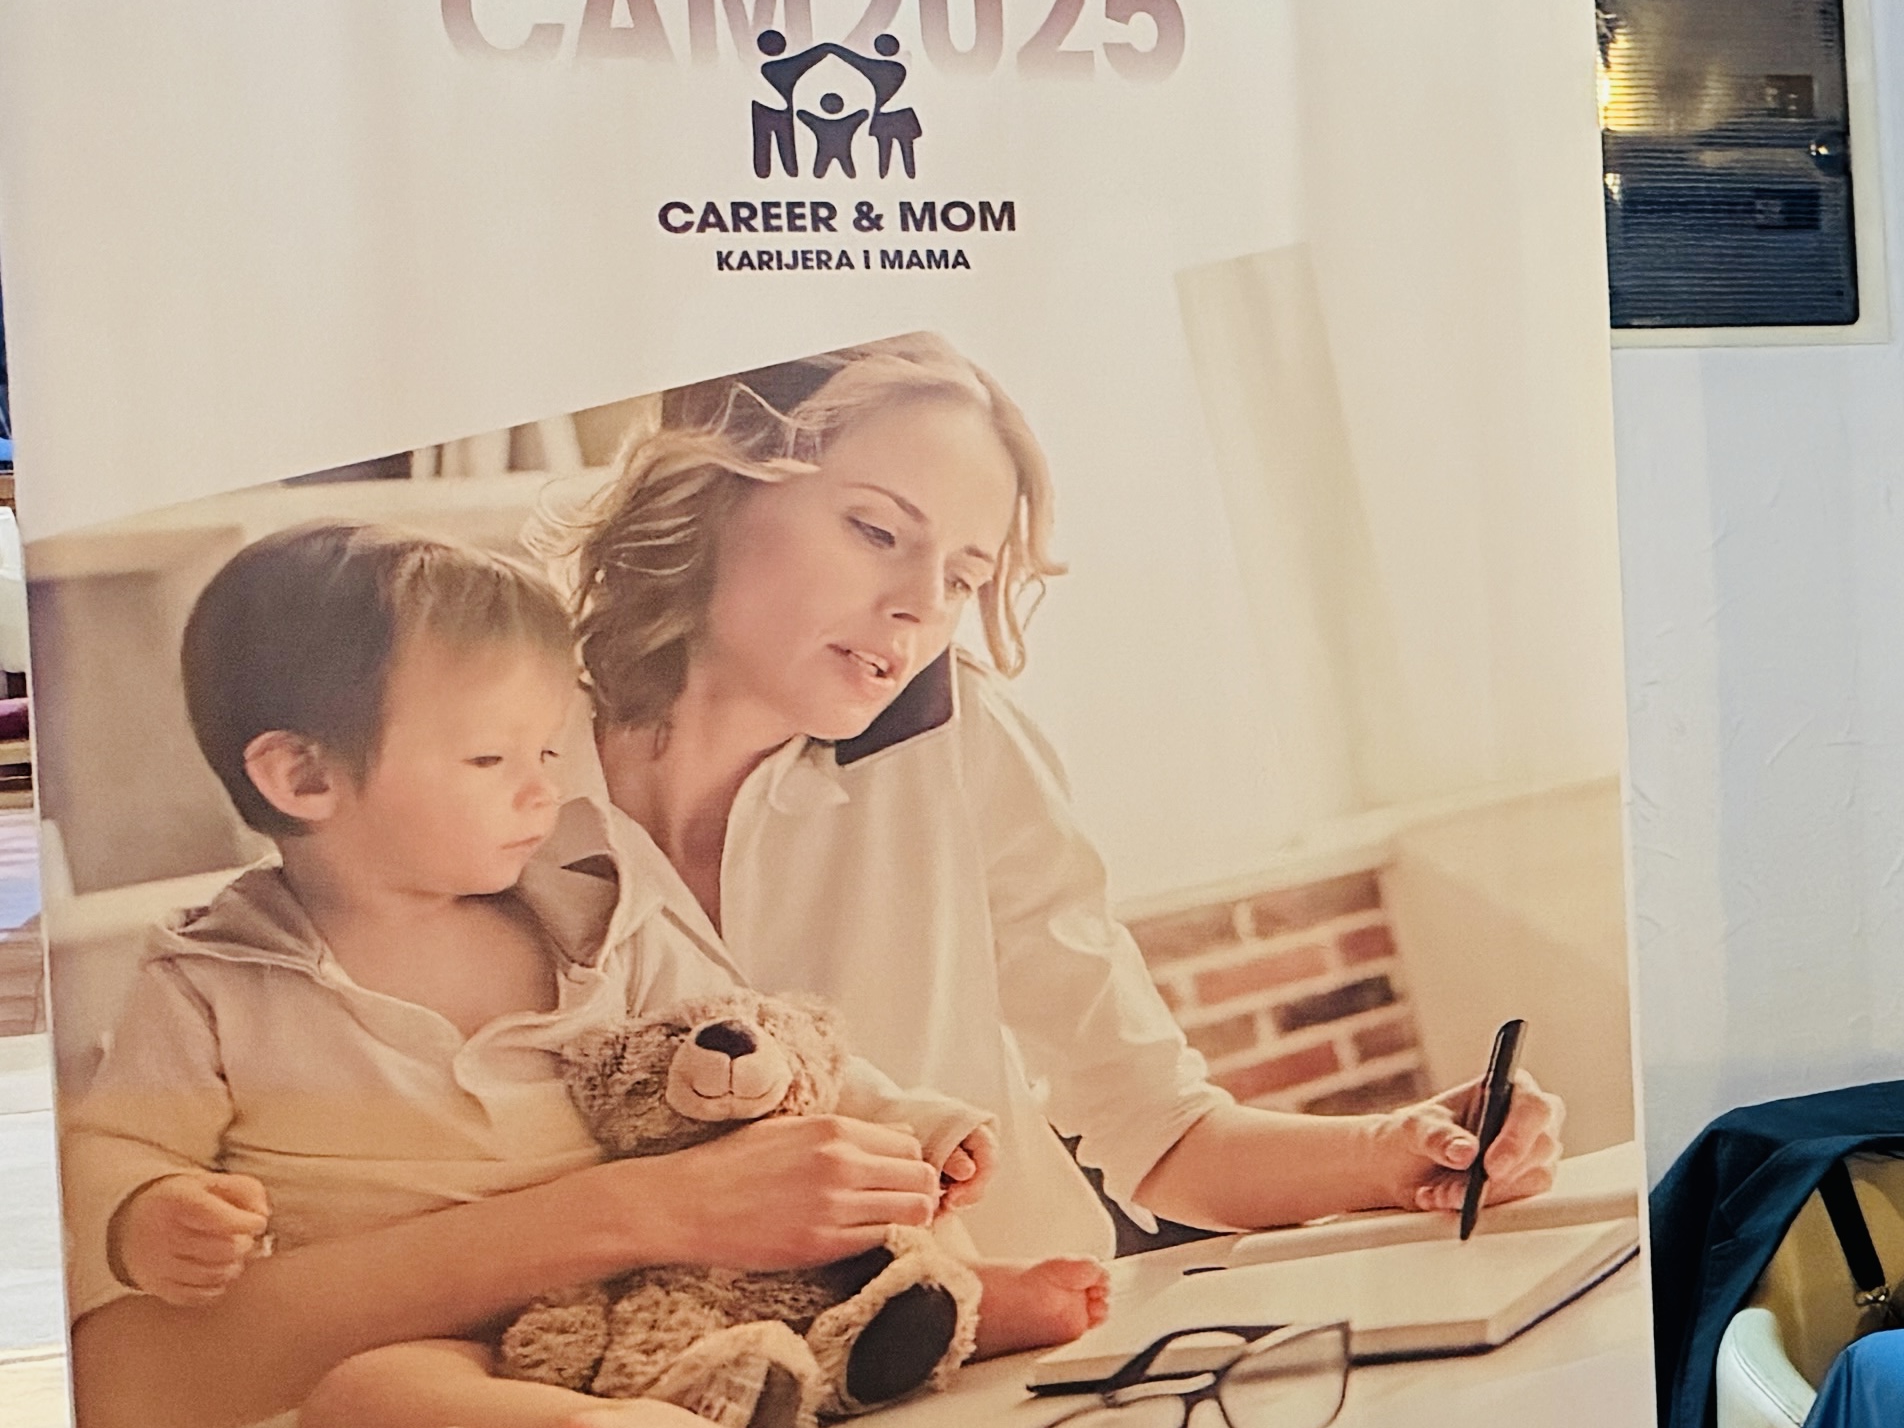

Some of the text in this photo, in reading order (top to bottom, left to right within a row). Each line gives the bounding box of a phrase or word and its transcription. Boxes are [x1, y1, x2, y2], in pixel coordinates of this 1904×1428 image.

[658, 200, 1017, 234] CAREER & MOM
[716, 249, 856, 271] KARIJERA
[880, 249, 972, 270] MAMA
